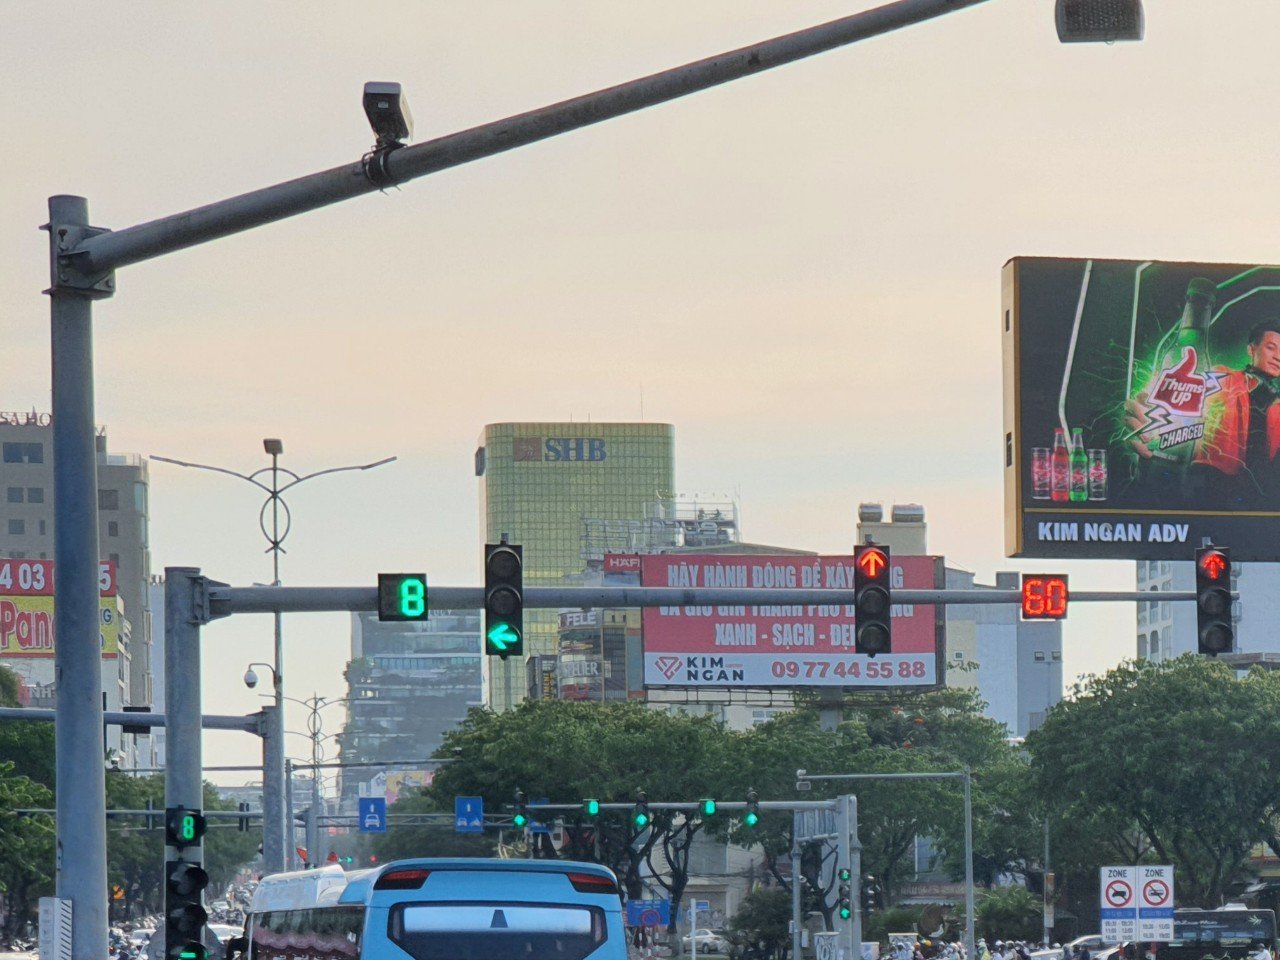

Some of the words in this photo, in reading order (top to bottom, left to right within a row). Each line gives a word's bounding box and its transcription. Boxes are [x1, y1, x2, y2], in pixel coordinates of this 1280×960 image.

[1162, 378, 1203, 393] Thums
[1170, 391, 1192, 406] UP
[544, 437, 607, 462] SHB
[1038, 522, 1078, 541] KIM
[1084, 523, 1142, 542] NGAN
[1148, 524, 1189, 542] ADV
[18, 563, 45, 590] 03
[667, 561, 699, 587] HÃY
[704, 561, 747, 587] HÀNH
[401, 578, 425, 617] 8
[715, 624, 756, 646] XANH
[772, 623, 815, 650] SẠCH
[687, 656, 724, 668] KIM
[771, 661, 799, 678] 09
[803, 661, 829, 678] 77
[834, 661, 860, 678] 44
[866, 661, 893, 678] 55
[898, 661, 926, 678] 88
[687, 670, 744, 681] NGAN
[183, 816, 194, 839] 8
[1108, 869, 1127, 878] ZONE
[1145, 869, 1164, 877] ZONE
